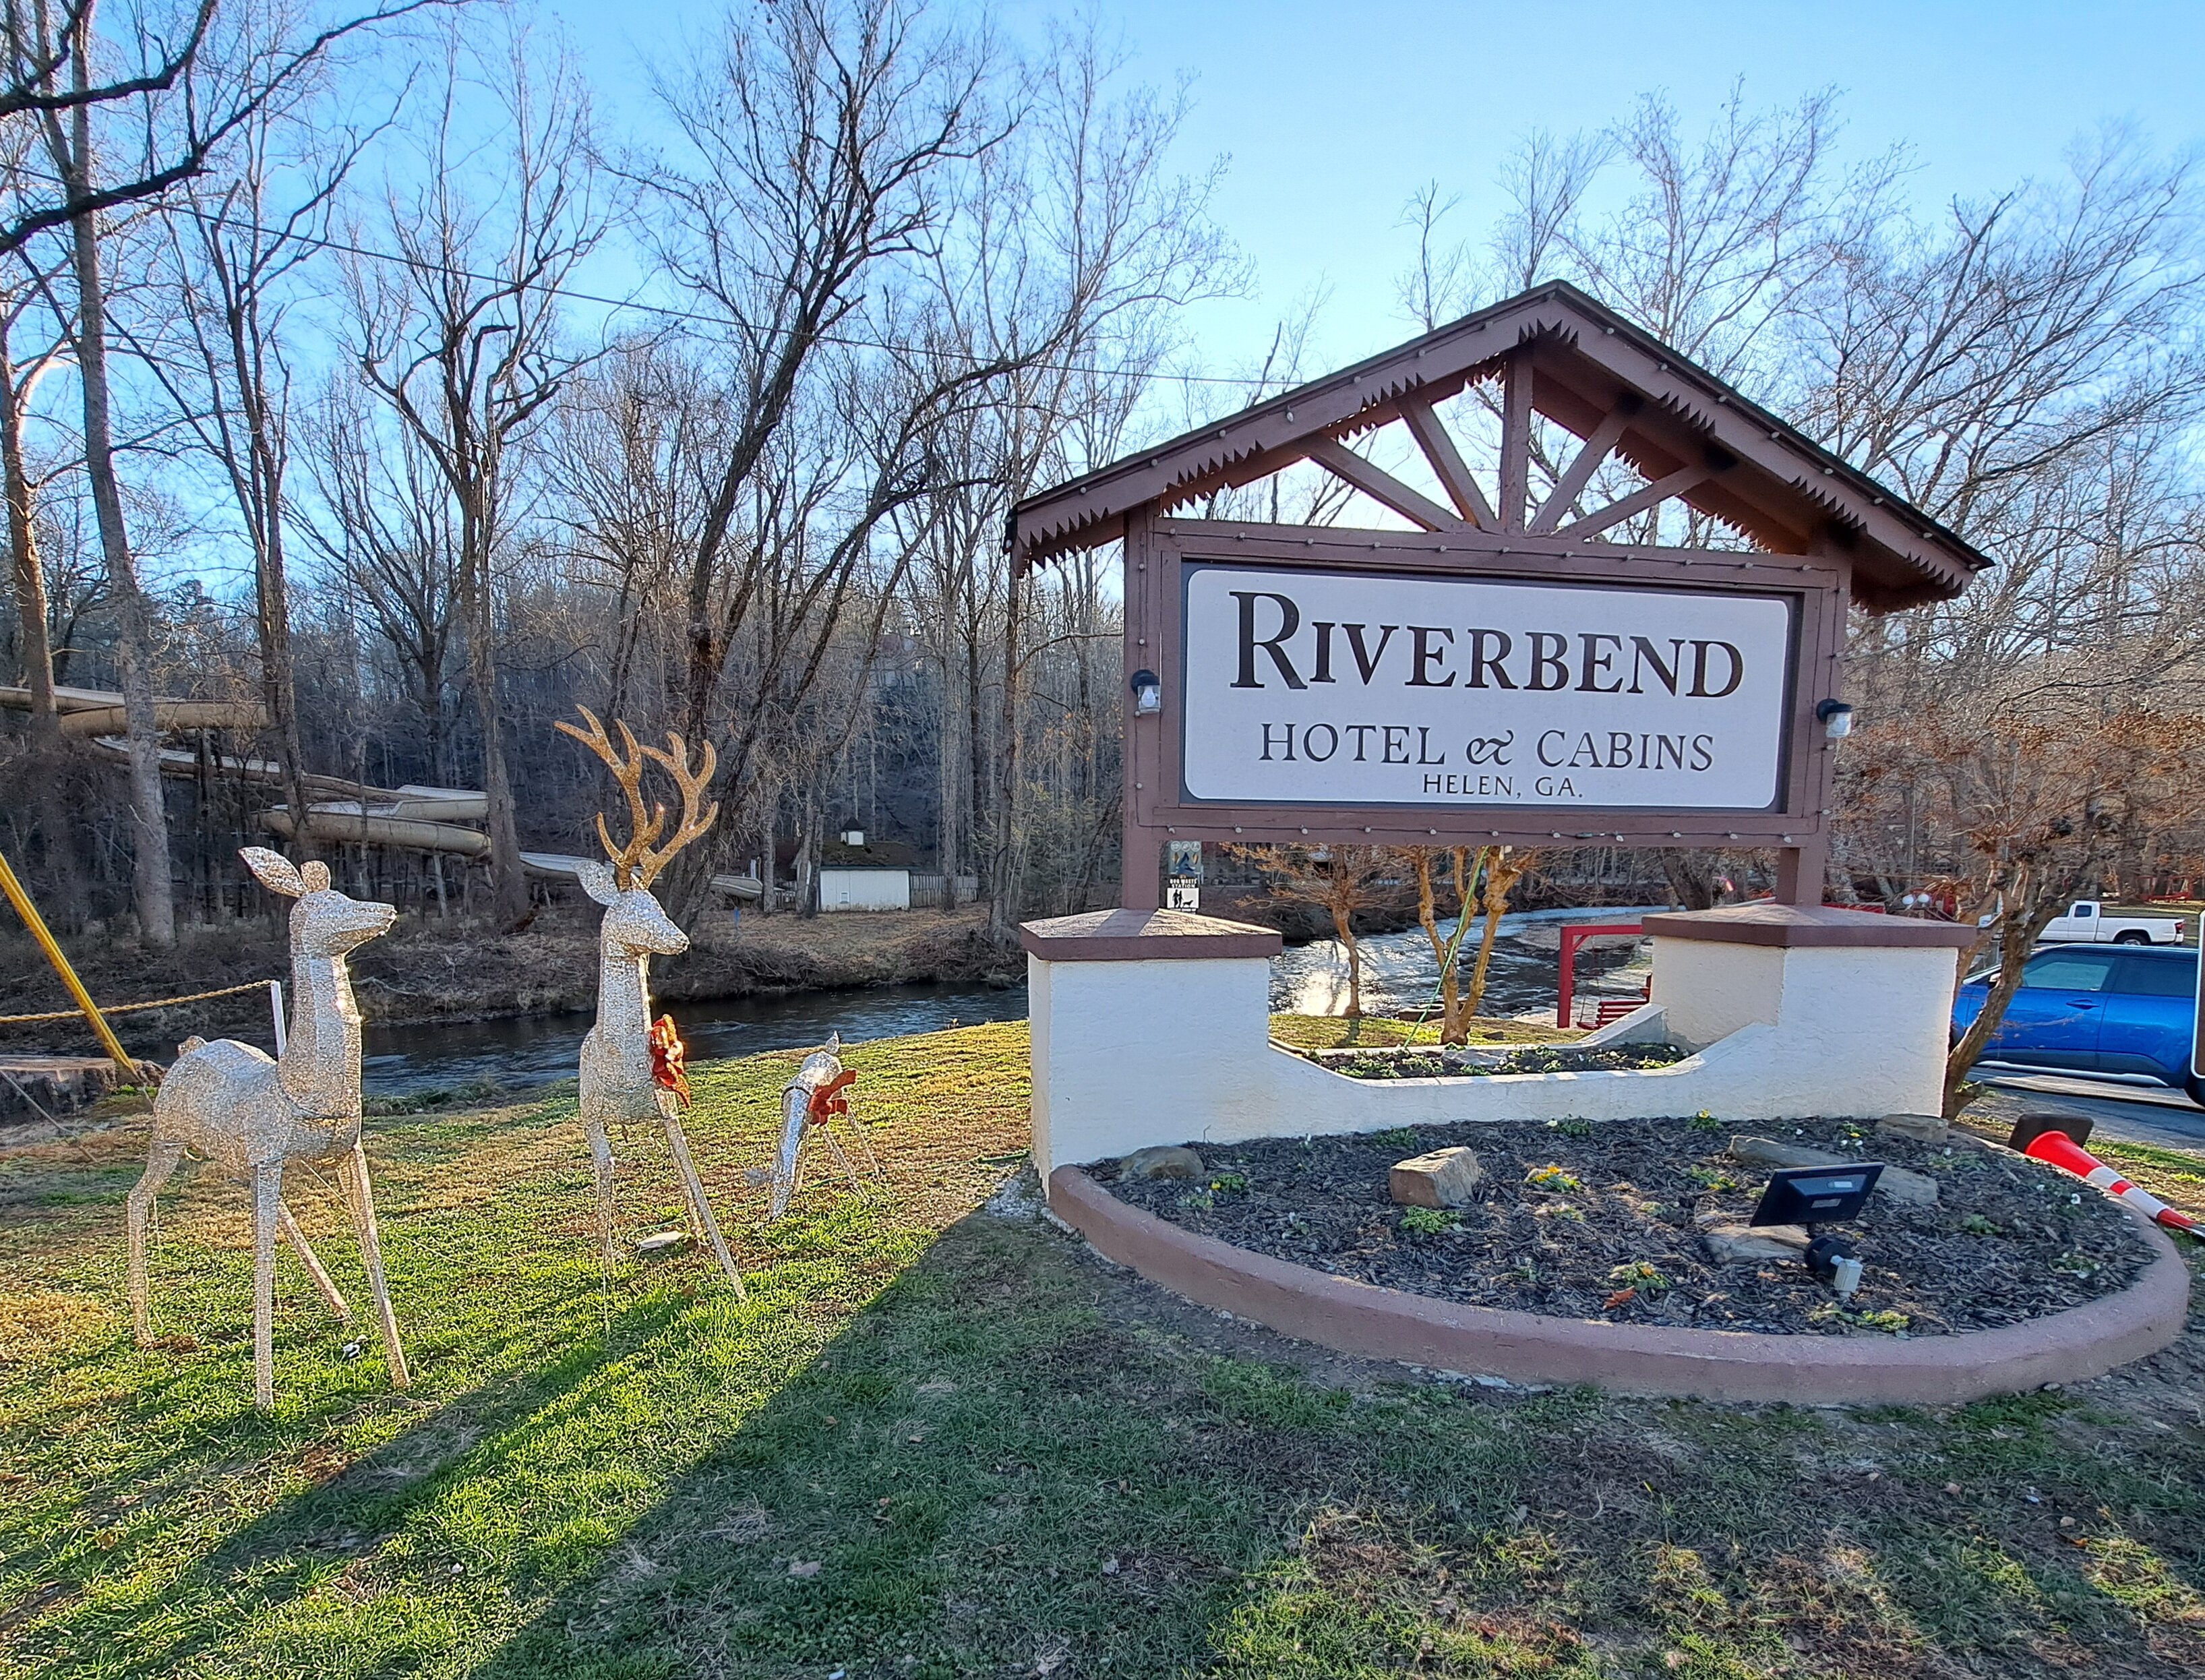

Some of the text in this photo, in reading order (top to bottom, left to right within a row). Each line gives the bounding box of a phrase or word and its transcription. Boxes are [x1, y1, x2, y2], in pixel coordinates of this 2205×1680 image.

[1229, 591, 1744, 698] RIVERBEND
[1259, 723, 1714, 772] HOTEL & CABINS
[1422, 773, 1584, 800] HELEN, GA.
